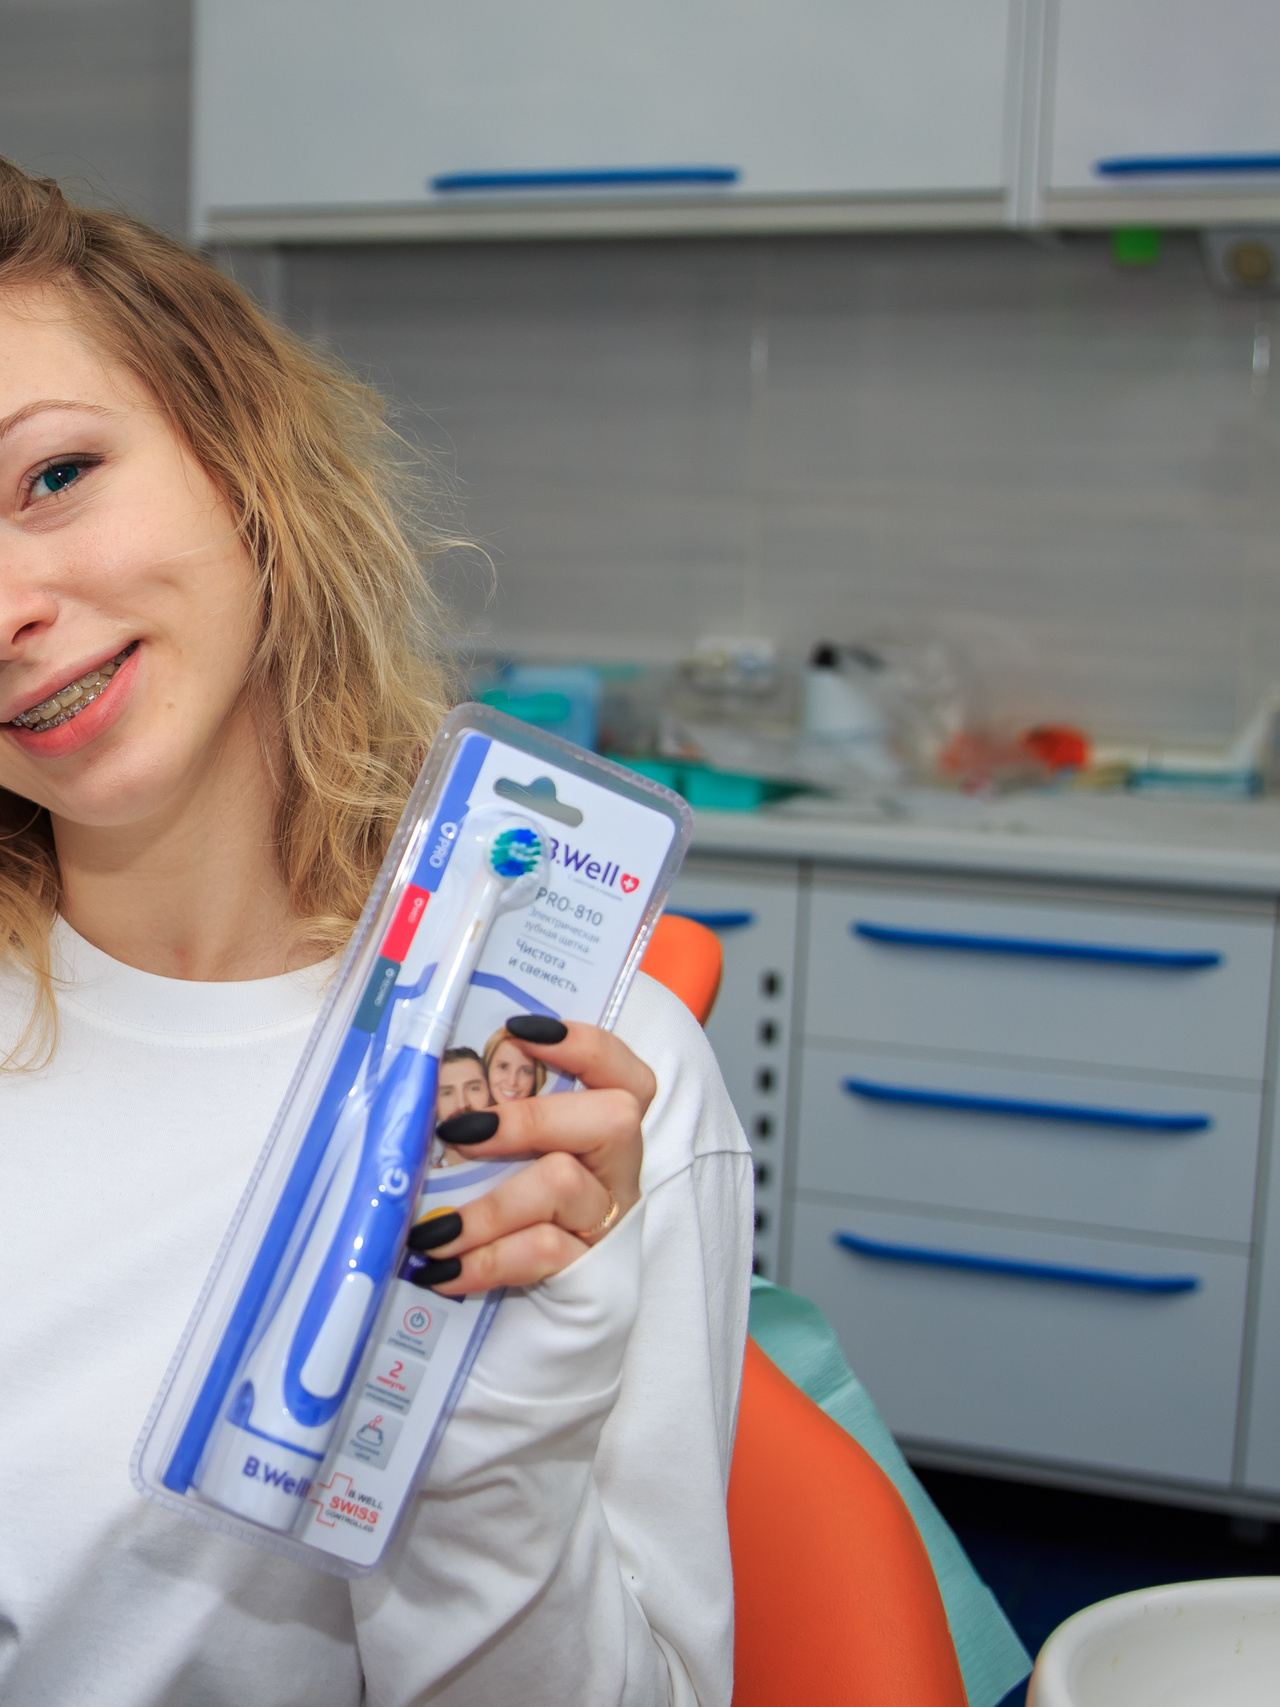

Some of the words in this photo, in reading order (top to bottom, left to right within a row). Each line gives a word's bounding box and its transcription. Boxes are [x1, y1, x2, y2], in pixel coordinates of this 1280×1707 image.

[429, 837, 452, 868] PRO
[535, 887, 603, 926] PRO-810
[524, 921, 557, 945] зубная
[558, 933, 590, 954] щетка
[528, 906, 600, 944] Электрическая
[516, 938, 567, 970] Чистота
[508, 956, 517, 968] и
[519, 960, 578, 994] свежесть
[389, 1361, 404, 1379] 2
[241, 1455, 312, 1500] B.Well
[328, 1496, 379, 1525] SWISS
[348, 1489, 383, 1510] B.WELL
[325, 1509, 374, 1533] CONTROLLED
